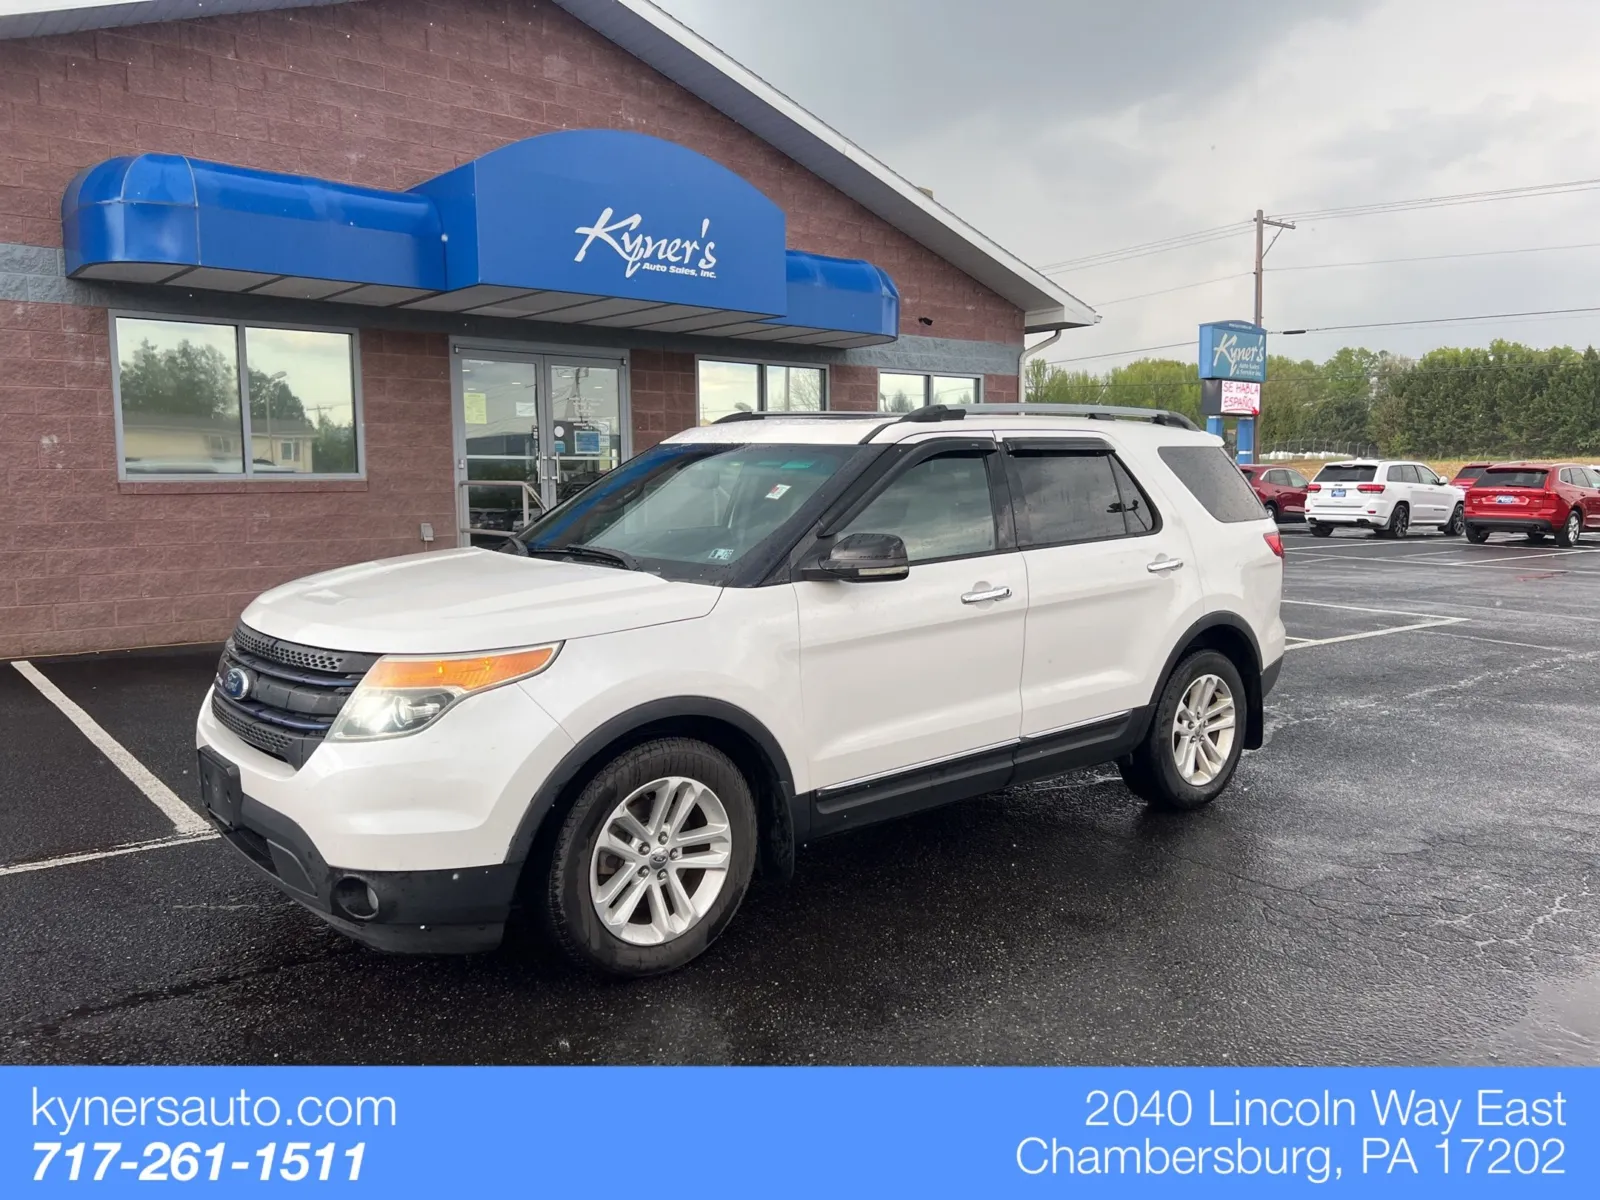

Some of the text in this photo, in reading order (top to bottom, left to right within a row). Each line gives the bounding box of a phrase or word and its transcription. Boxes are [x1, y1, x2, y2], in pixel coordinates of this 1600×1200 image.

[574, 207, 717, 278] Kyner's
[642, 262, 667, 273] Auto
[669, 265, 698, 277] Sales,
[1213, 333, 1264, 376] Kyner's
[1224, 382, 1258, 395] SE HABLA
